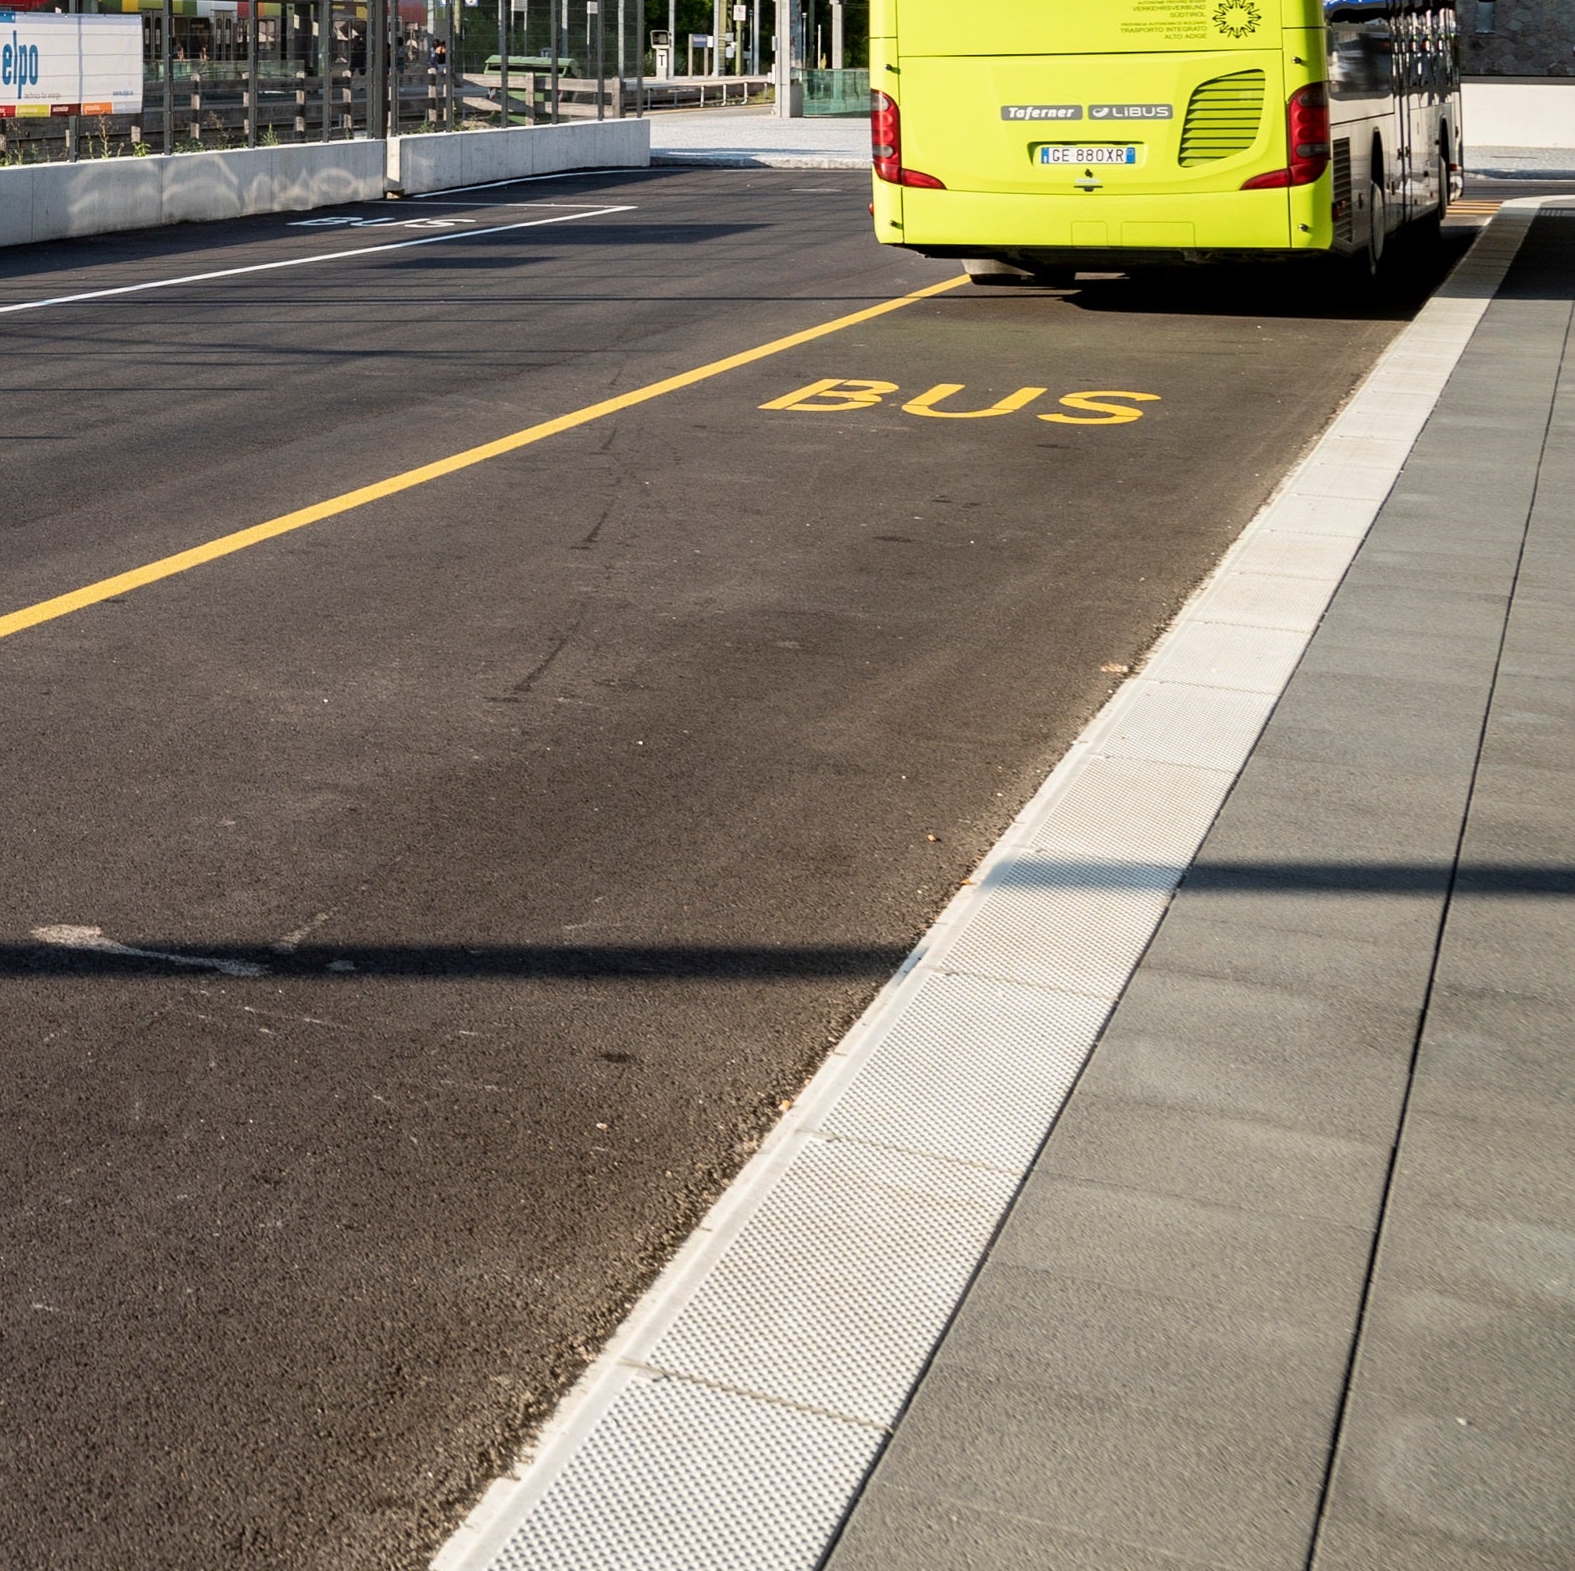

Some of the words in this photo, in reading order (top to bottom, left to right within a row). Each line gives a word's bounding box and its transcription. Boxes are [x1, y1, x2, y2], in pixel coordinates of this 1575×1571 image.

[2, 30, 38, 99] elpo
[658, 54, 665, 66] T
[1008, 106, 1075, 120] Taferner
[1052, 148, 1070, 162] GE
[286, 216, 476, 228] BUS
[756, 378, 1162, 425] BUS
